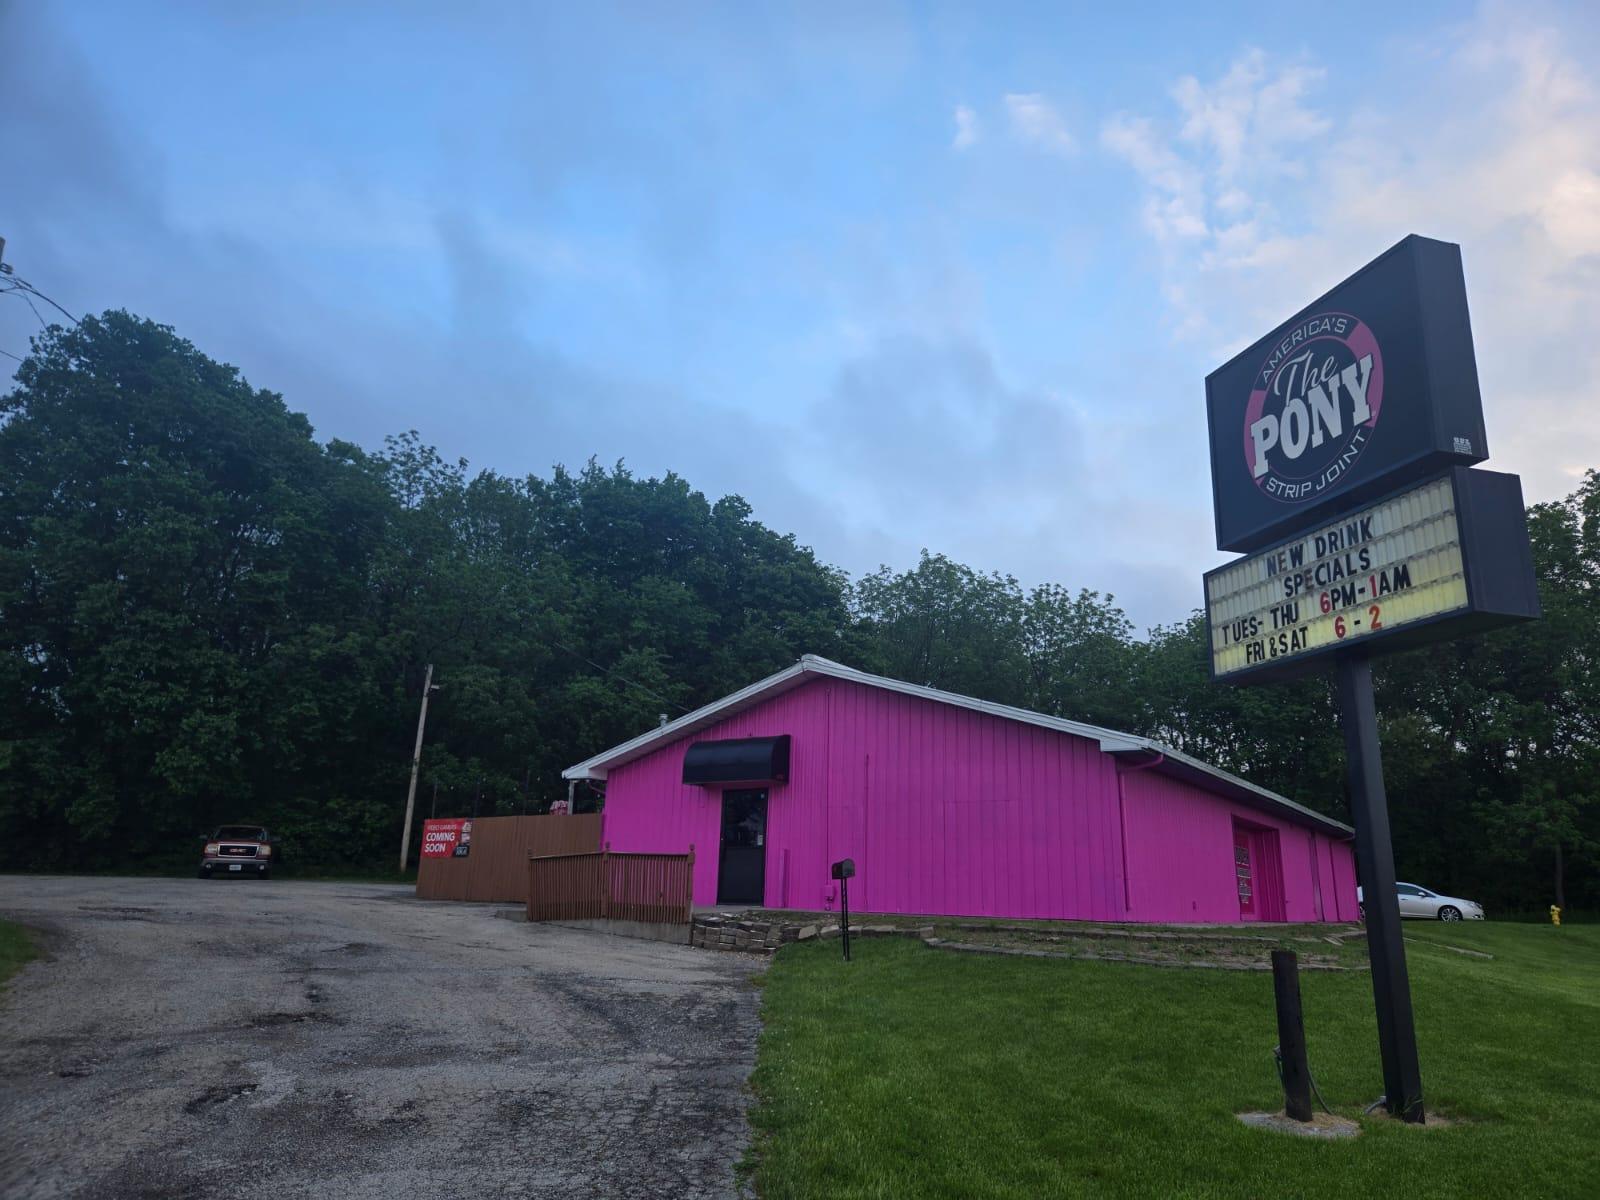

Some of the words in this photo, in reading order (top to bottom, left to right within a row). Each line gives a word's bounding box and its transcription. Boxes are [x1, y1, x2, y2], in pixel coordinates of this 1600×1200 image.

[1262, 318, 1348, 384] AMERICA'S
[1273, 350, 1338, 407] The
[1250, 353, 1374, 479] PONY
[1266, 477, 1313, 498] STRIP
[1316, 428, 1366, 491] JOINT
[1267, 544, 1304, 577] NEW
[1315, 517, 1373, 558] DRINK
[1284, 548, 1371, 598] SPECIALS
[1245, 640, 1266, 665] FRI
[1334, 615, 1347, 639] 6
[1368, 604, 1383, 631] 2
[1270, 601, 1299, 630] THU
[425, 843, 446, 852] SOON
[426, 832, 455, 841] COMING
